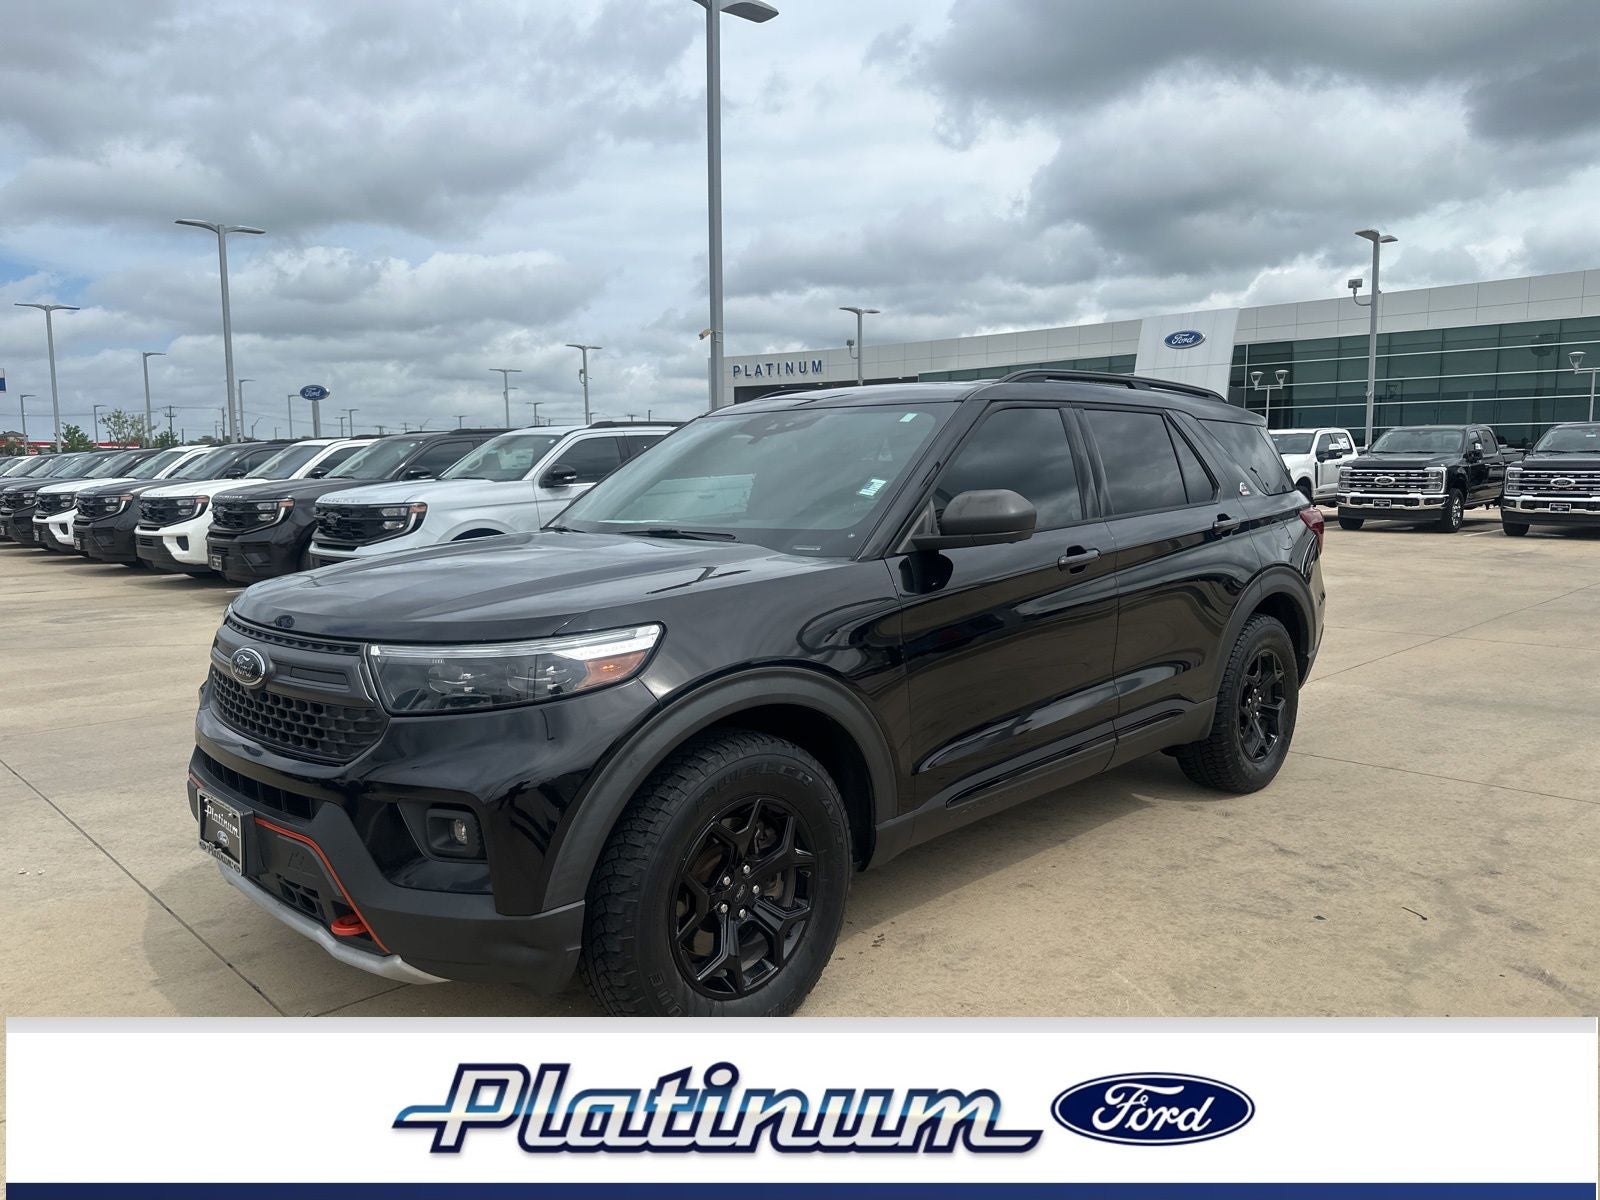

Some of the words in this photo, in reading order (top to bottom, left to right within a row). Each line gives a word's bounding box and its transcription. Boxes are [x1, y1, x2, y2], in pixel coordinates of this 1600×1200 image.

[1171, 333, 1195, 345] Ford
[733, 360, 822, 377] PLATINUM
[204, 804, 240, 839] Platinum
